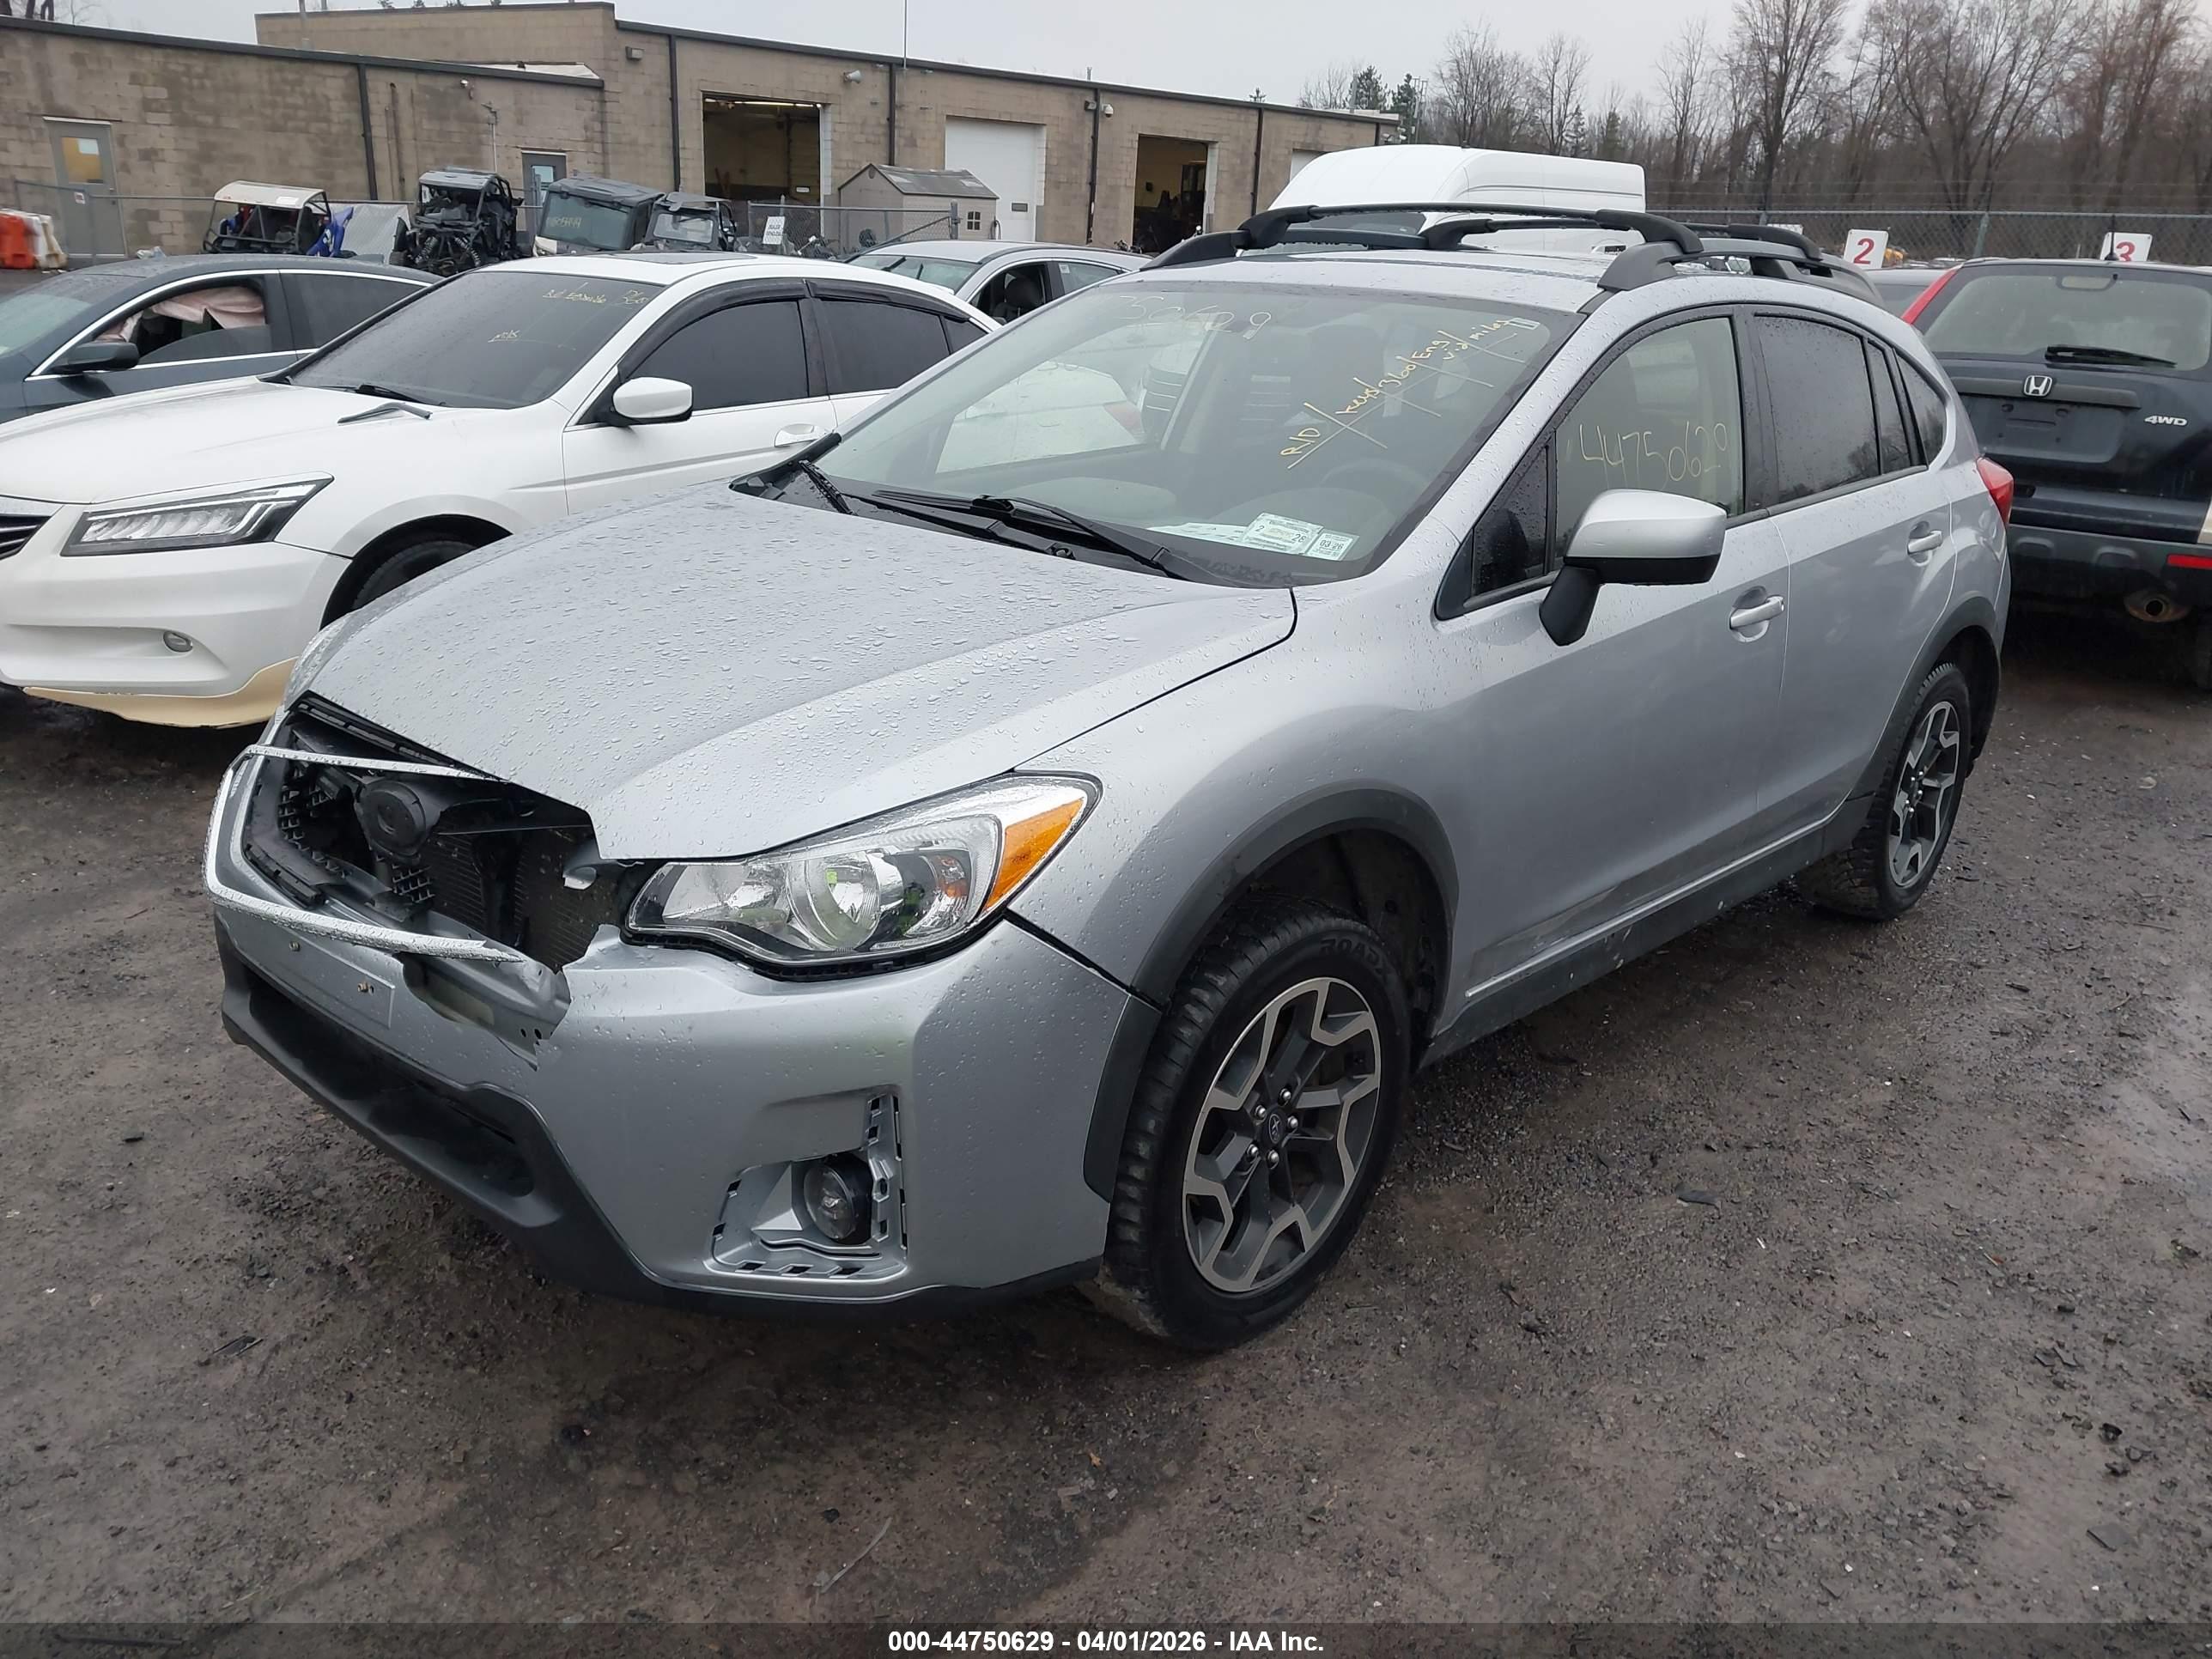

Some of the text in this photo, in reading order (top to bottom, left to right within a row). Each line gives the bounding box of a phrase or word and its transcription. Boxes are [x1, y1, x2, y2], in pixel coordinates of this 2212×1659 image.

[1853, 238, 1875, 264] 2
[2116, 241, 2136, 261] 3
[2144, 415, 2187, 427] 4WD
